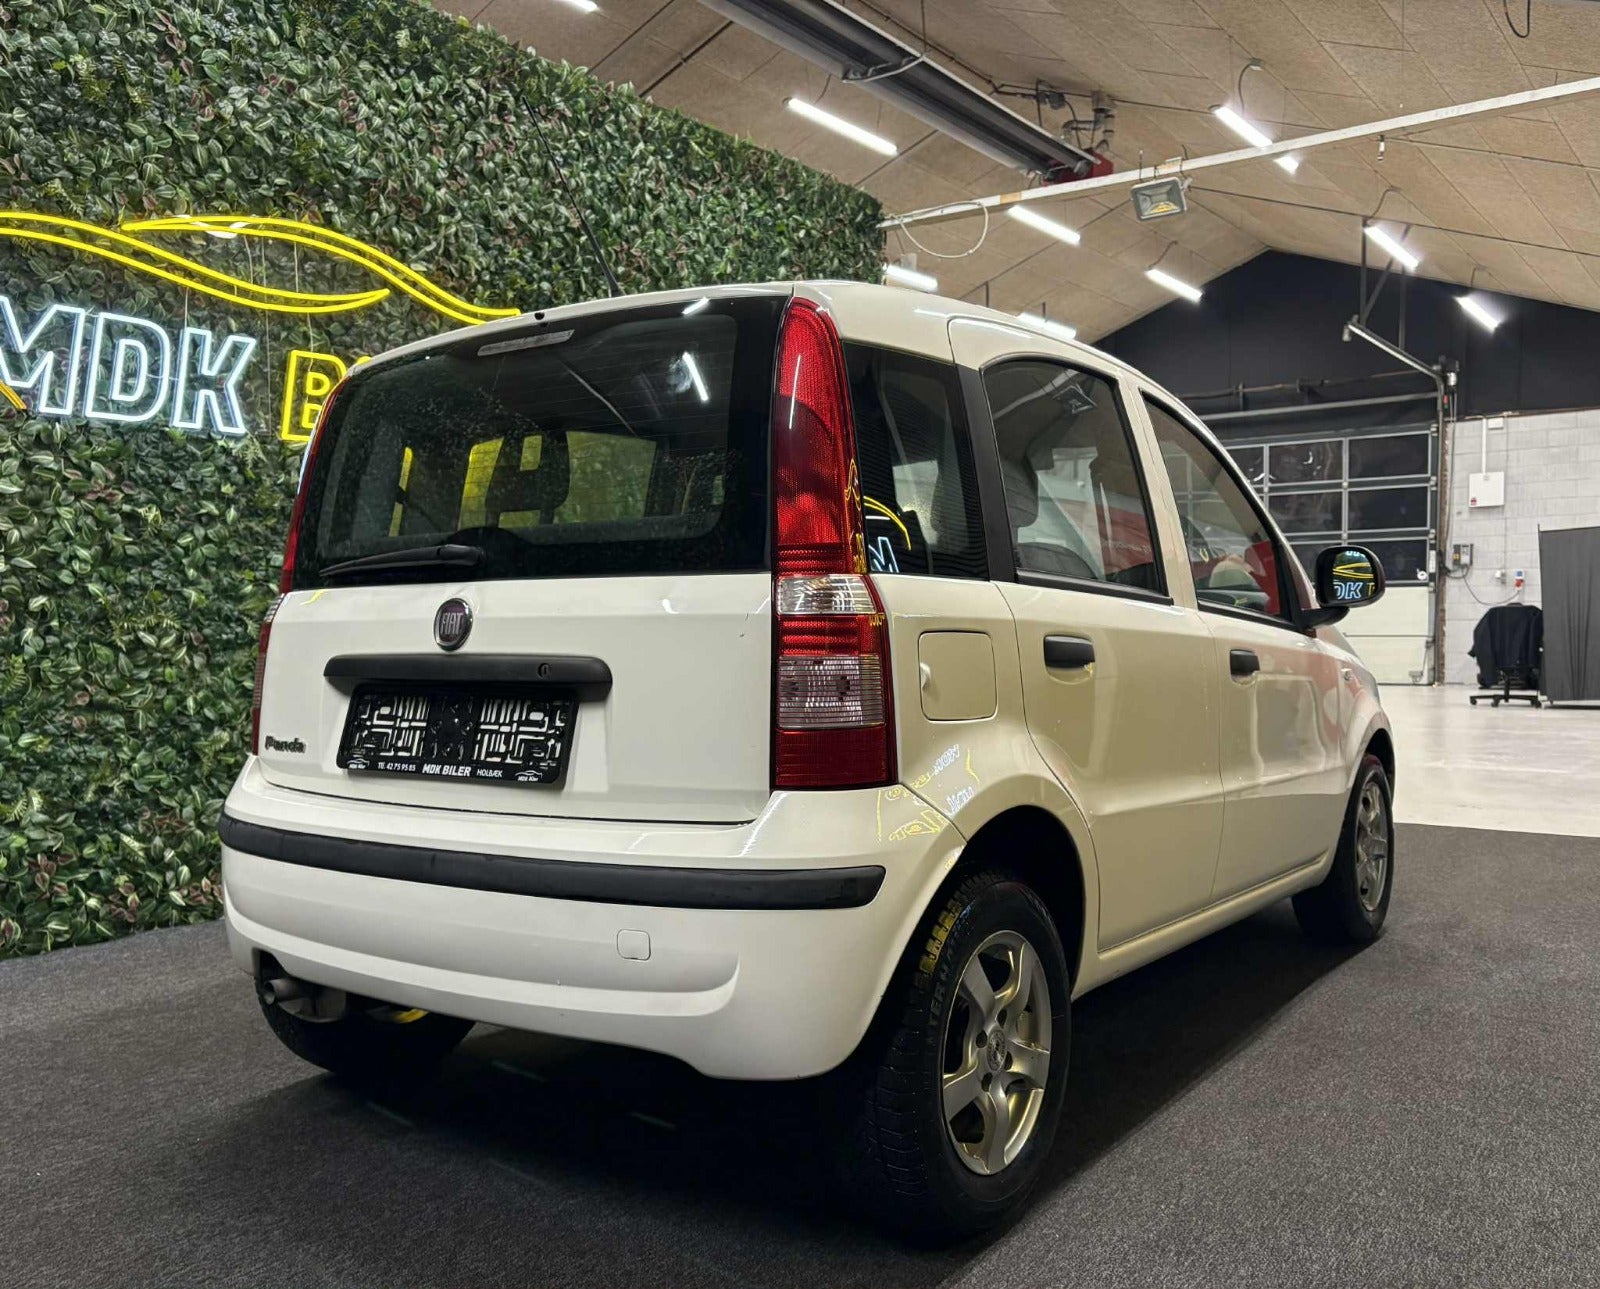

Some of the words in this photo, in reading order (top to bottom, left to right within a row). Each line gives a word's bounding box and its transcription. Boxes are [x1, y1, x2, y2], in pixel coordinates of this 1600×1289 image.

[0, 295, 257, 436] MDK
[440, 611, 464, 635] FIAT
[386, 762, 394, 771] 42
[421, 763, 442, 775] MDK
[441, 765, 472, 777] BILER
